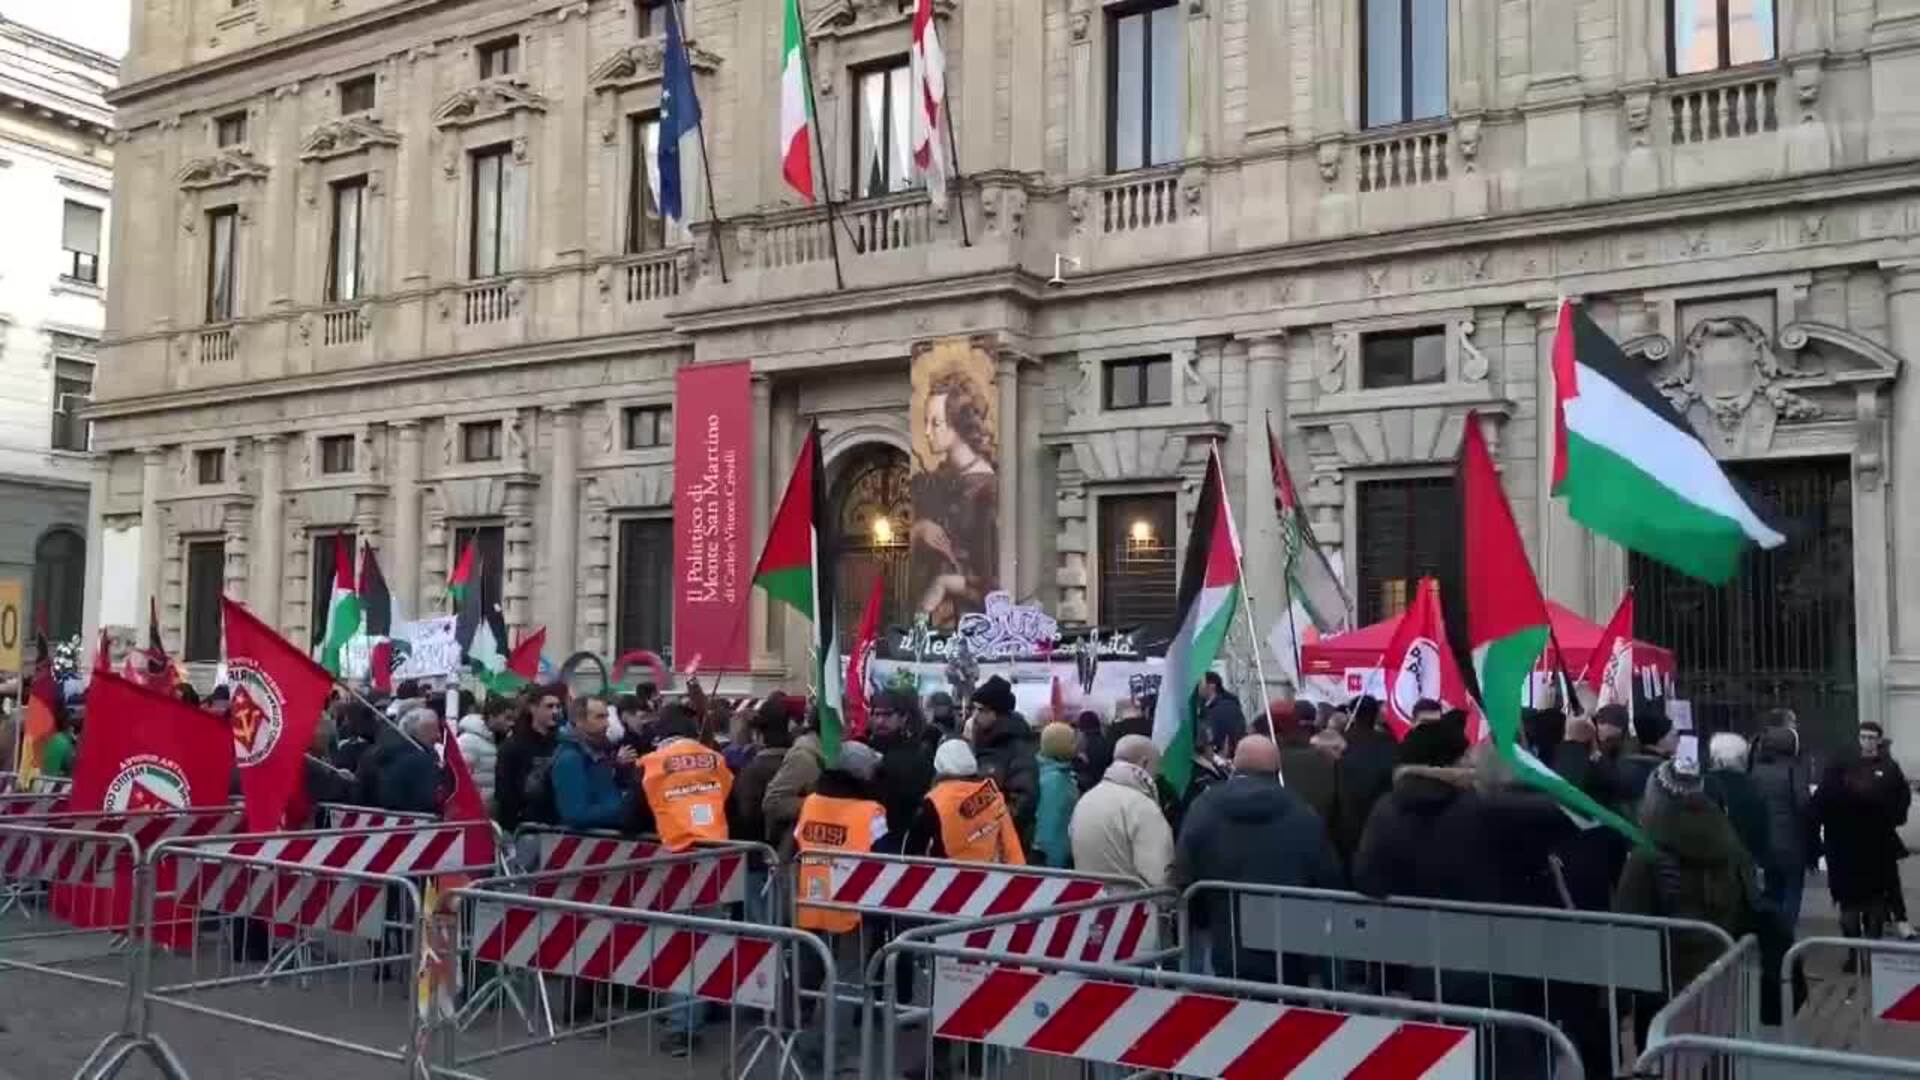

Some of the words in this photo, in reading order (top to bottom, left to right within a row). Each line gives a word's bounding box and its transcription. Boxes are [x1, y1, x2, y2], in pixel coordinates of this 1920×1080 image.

[703, 415, 720, 495] Martino
[687, 485, 704, 502] di
[703, 501, 720, 537] San
[687, 507, 704, 582] Polittico
[703, 543, 720, 602] Monte
[725, 589, 736, 602] di
